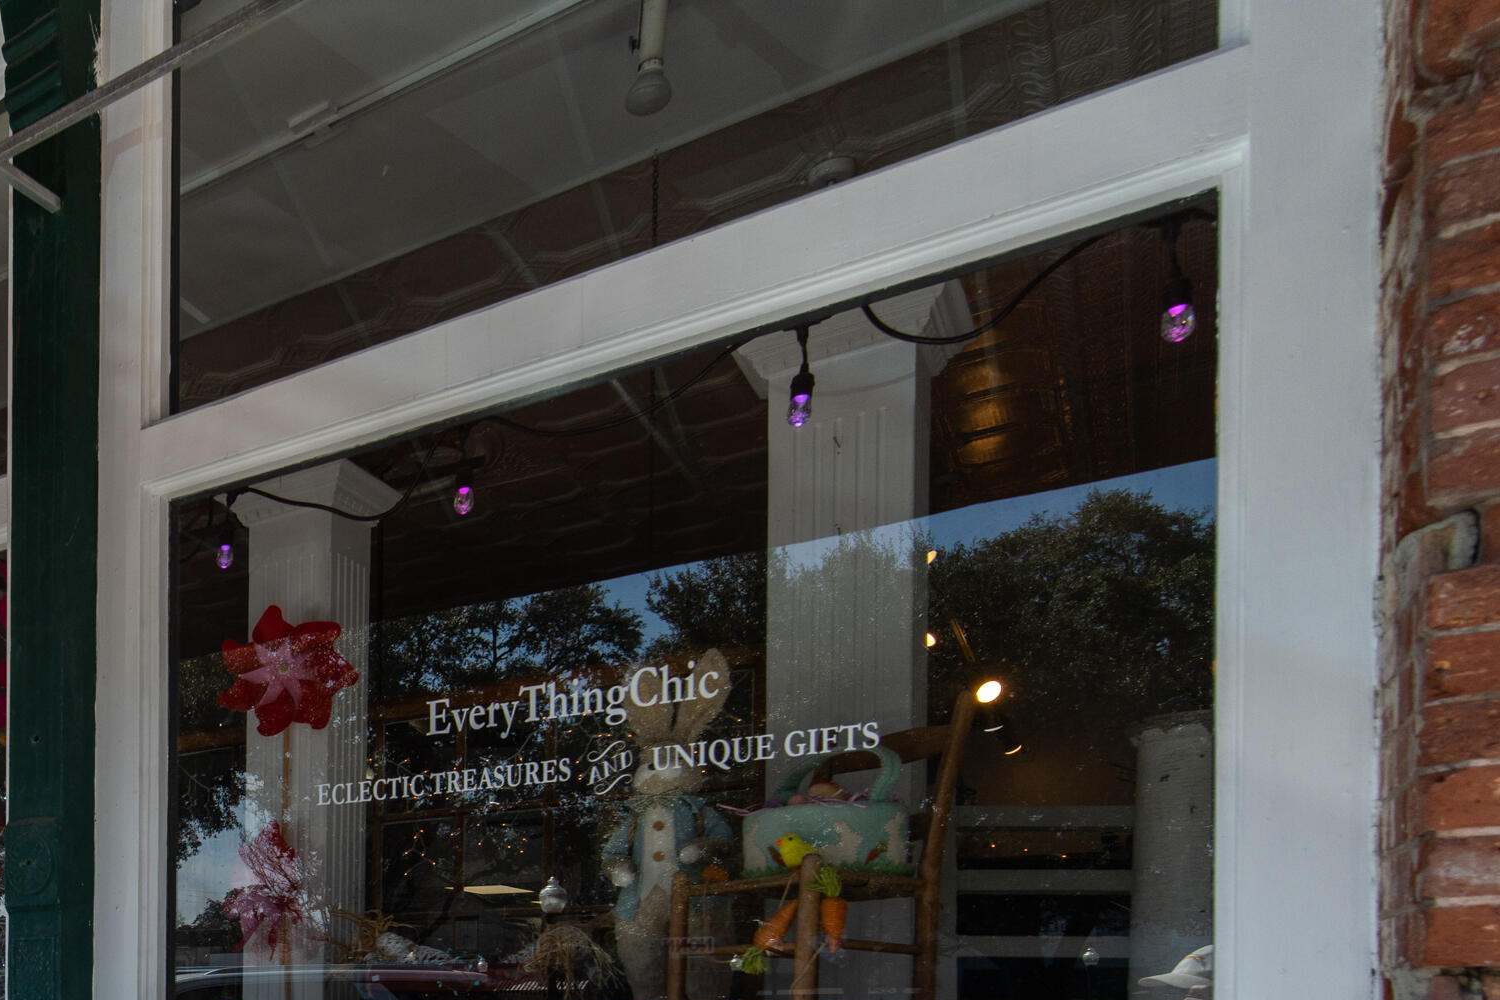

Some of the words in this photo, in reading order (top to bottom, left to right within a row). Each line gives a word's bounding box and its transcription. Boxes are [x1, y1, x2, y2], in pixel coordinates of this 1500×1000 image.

[425, 663, 720, 740] EveryThingChic
[316, 772, 426, 807] ECLECTIC
[429, 757, 572, 796] TREASURES
[587, 745, 633, 790] AND
[651, 732, 778, 773] UNIQUE
[783, 721, 882, 760] GIFTS
